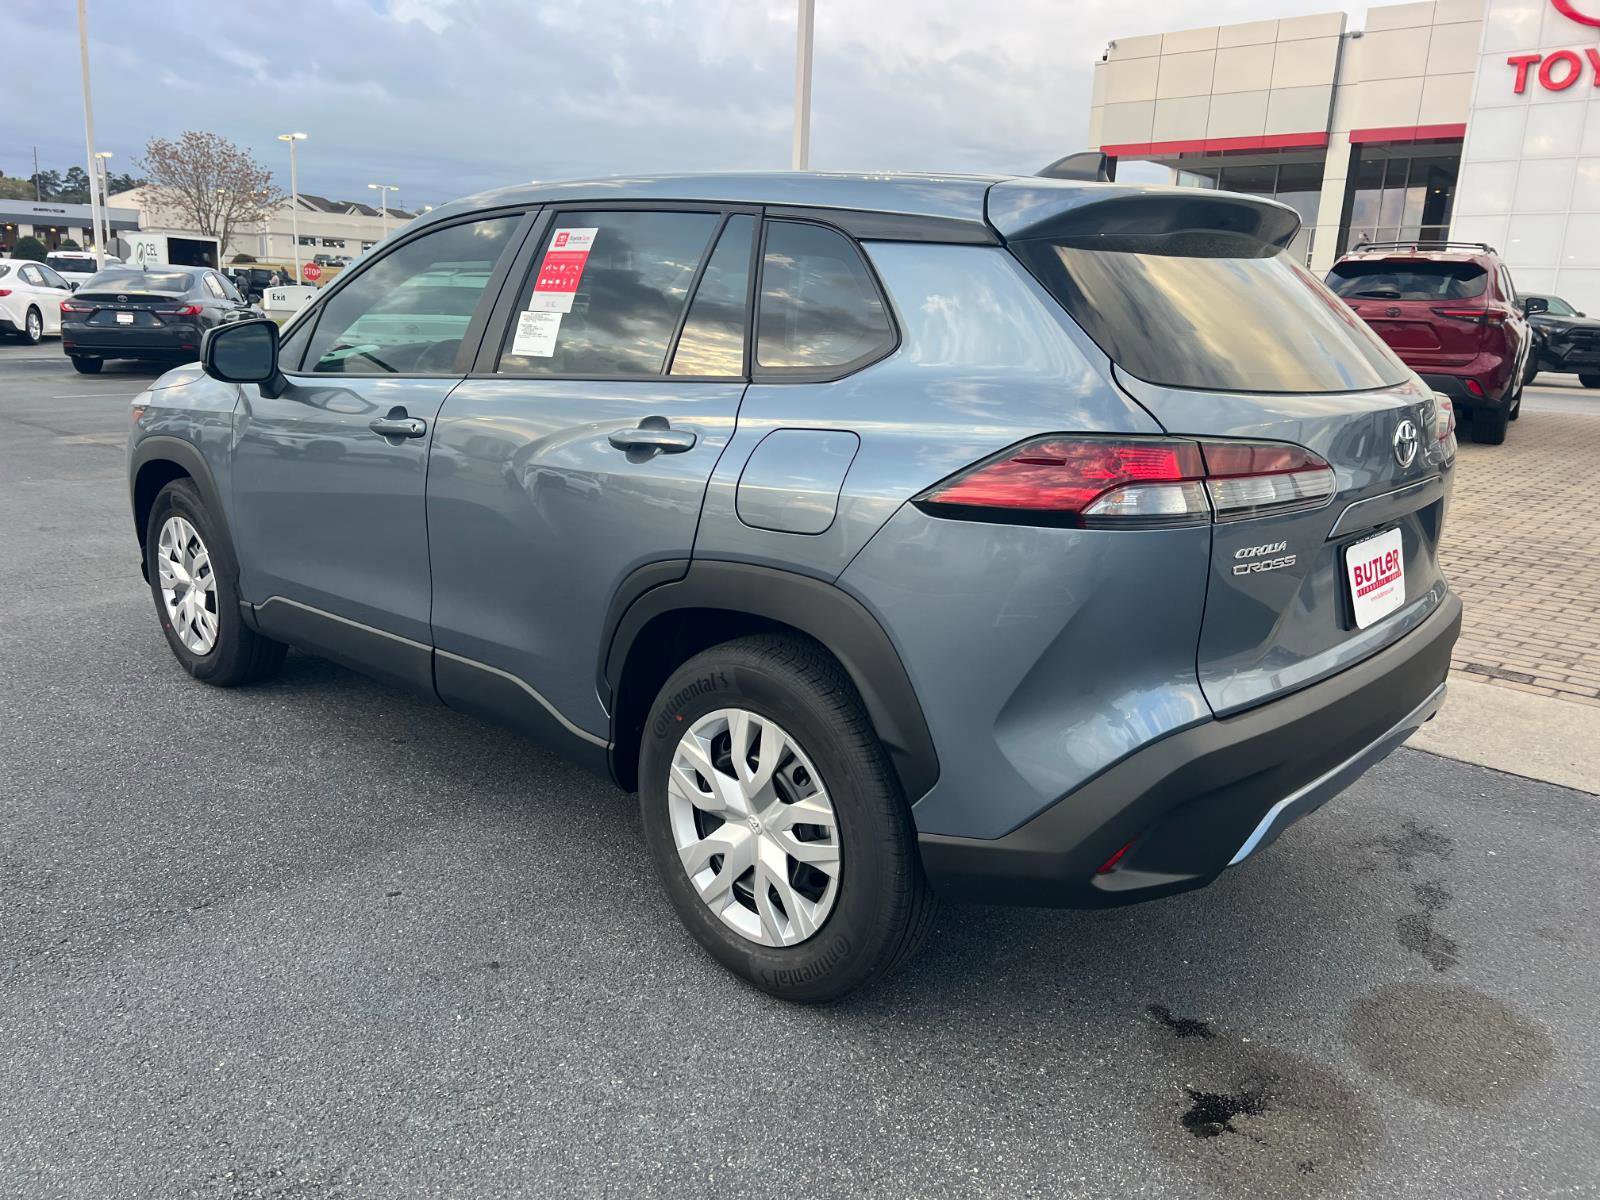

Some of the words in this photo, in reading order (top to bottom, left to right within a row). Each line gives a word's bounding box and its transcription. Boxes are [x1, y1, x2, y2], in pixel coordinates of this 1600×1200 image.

[304, 267, 321, 276] STOP
[272, 293, 286, 301] Exit
[1234, 540, 1287, 559] COROLLA
[1232, 554, 1297, 576] CROSS
[653, 672, 718, 739] Continental
[773, 934, 852, 988] Continental
